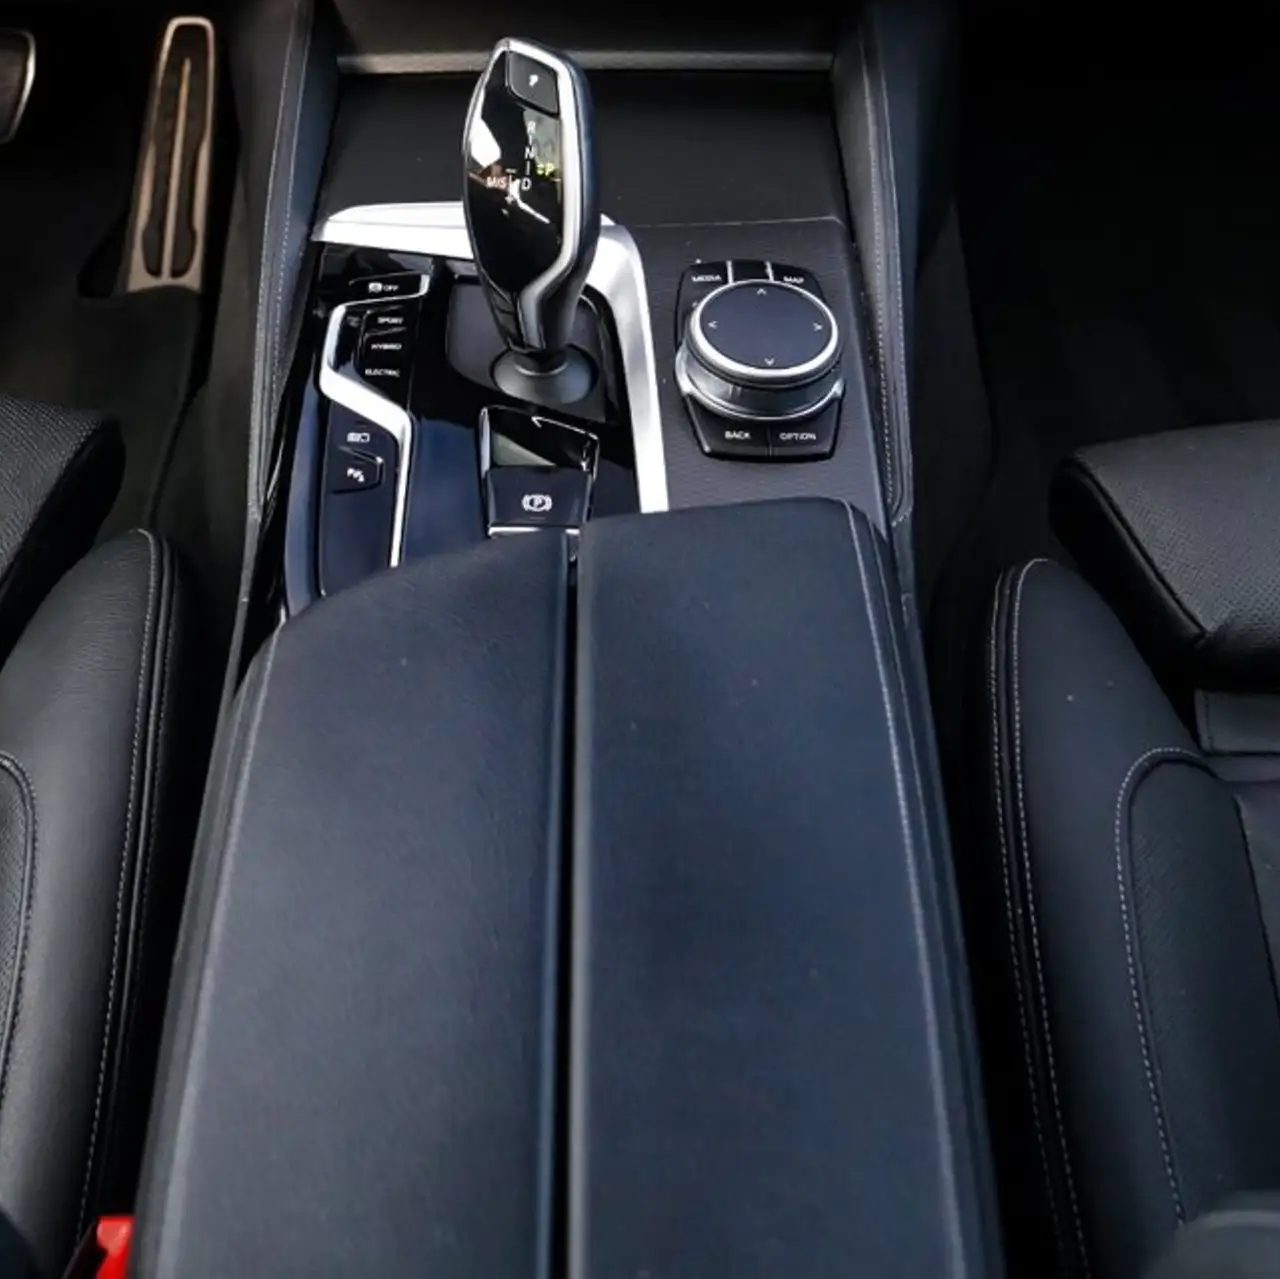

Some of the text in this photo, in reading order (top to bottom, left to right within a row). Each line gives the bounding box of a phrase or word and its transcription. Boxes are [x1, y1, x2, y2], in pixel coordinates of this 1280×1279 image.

[521, 177, 532, 191] D
[725, 430, 751, 440] BACK
[779, 432, 817, 441] OPTION
